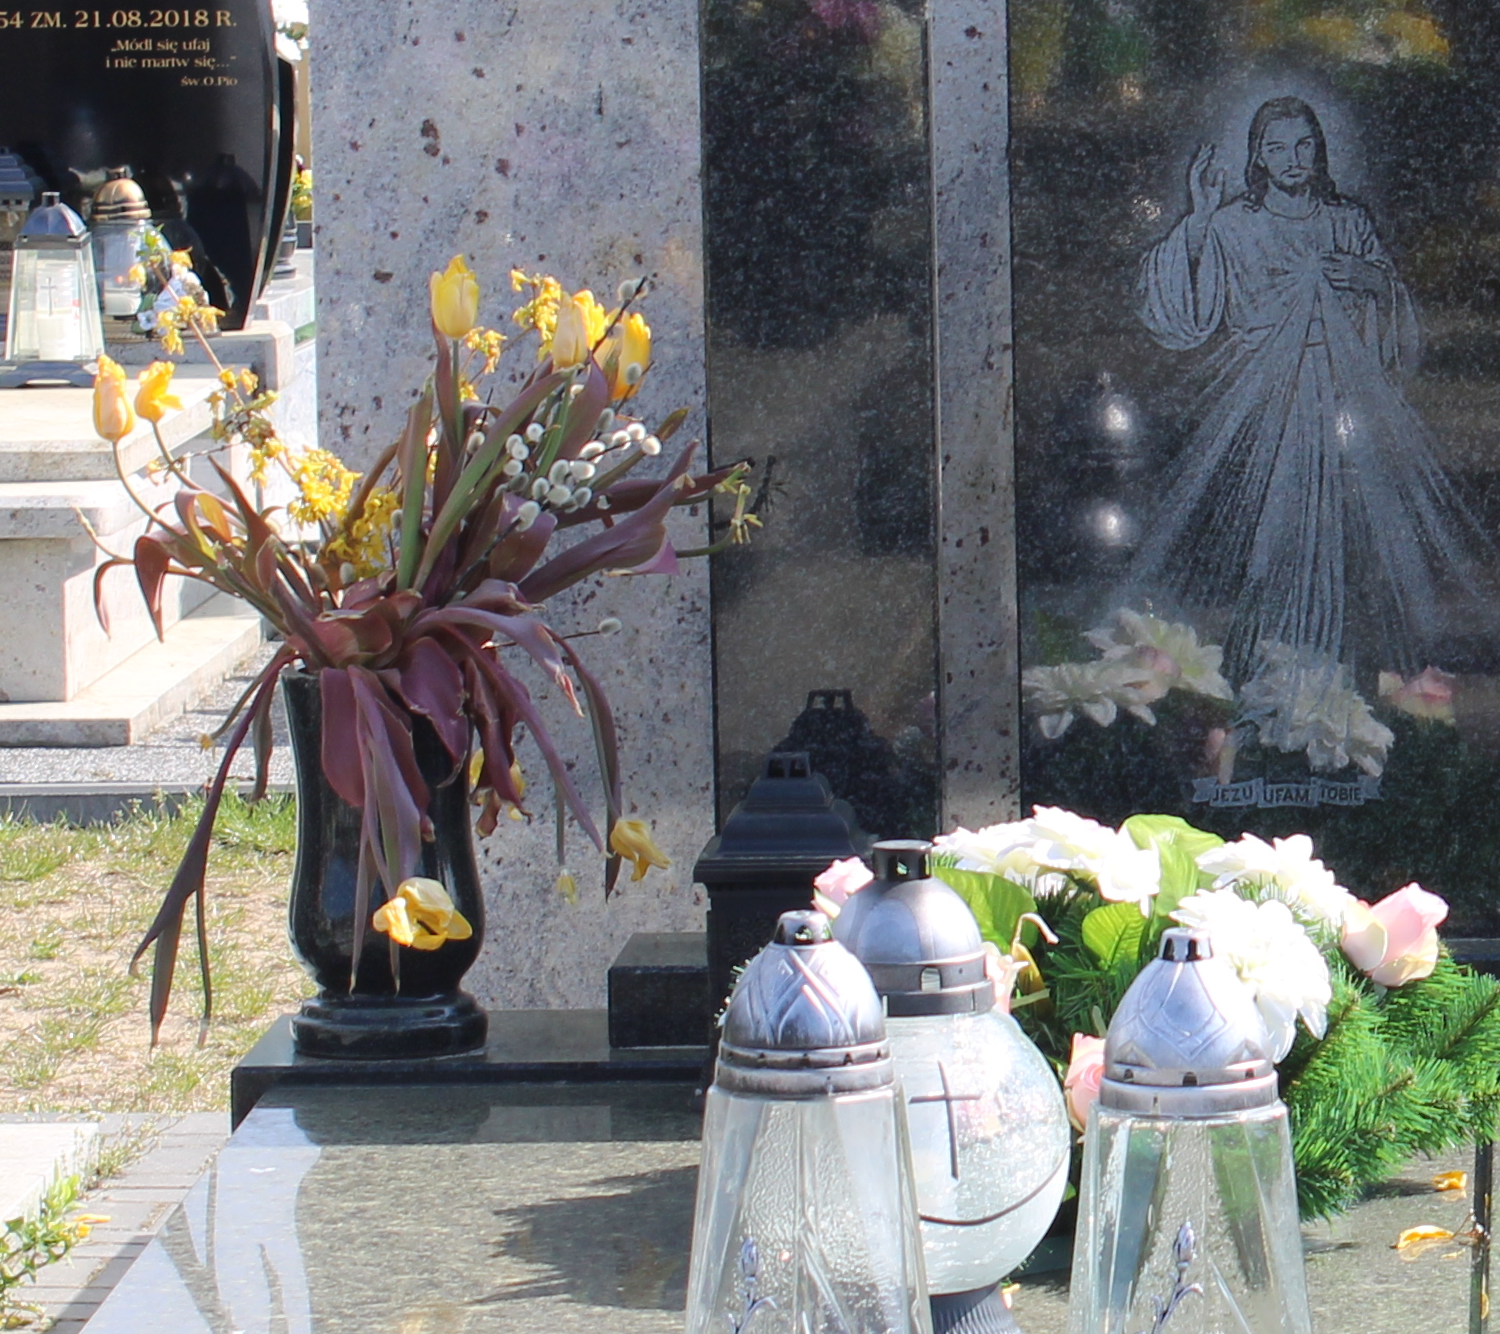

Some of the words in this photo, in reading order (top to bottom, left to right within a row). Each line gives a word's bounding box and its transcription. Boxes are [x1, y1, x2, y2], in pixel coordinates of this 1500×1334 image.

[30, 11, 67, 29] ZM.
[141, 57, 190, 68] martw
[1212, 786, 1254, 802] JEZU
[1263, 787, 1310, 804] UFAM
[1319, 786, 1362, 801] TOBIE
